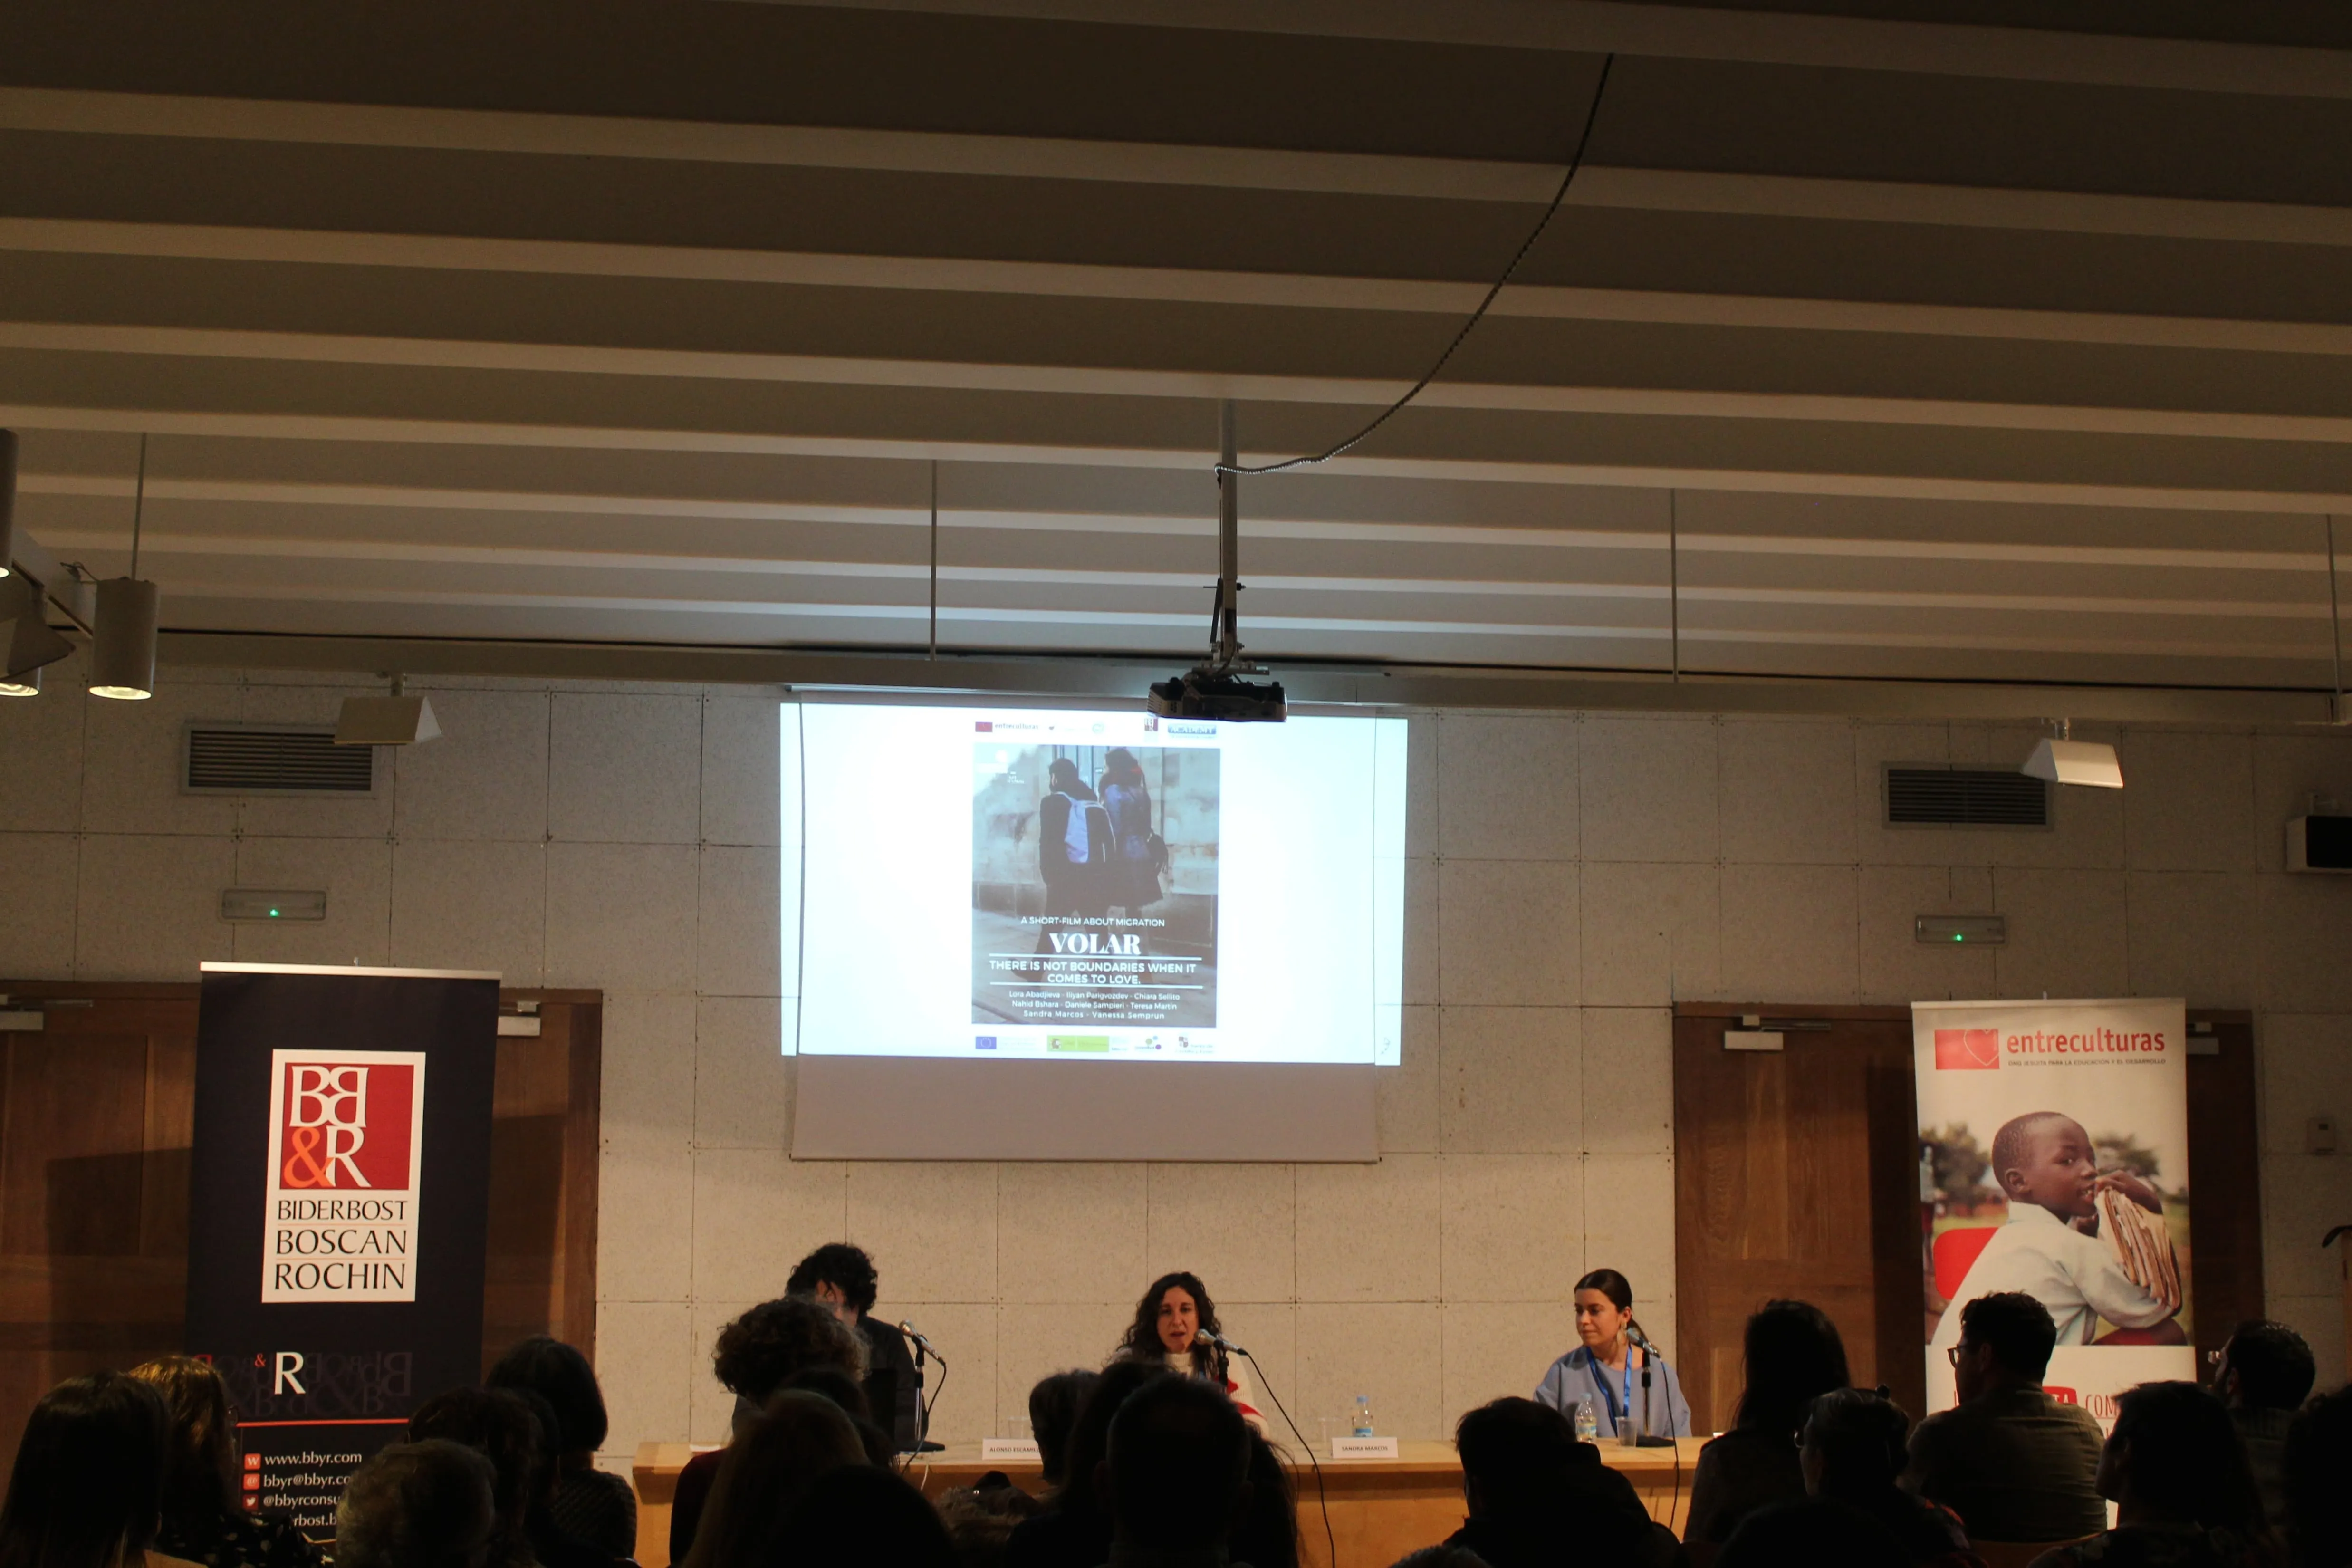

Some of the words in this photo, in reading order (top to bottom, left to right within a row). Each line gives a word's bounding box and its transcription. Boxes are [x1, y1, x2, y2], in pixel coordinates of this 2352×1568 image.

[1021, 916, 1027, 924] A
[1029, 916, 1081, 925] SHORT-FILM
[1083, 917, 1114, 926] ABOUT
[1116, 918, 1165, 926] MIGRATION
[1049, 933, 1142, 955] VOLAR
[989, 960, 1027, 970] THERE
[1030, 961, 1040, 971] IS
[1044, 961, 1067, 971] NOT
[1070, 962, 1145, 972] BOUNDARIES
[1148, 963, 1183, 973] WHEN
[1186, 964, 1197, 973] IT
[1047, 973, 1088, 983] COMES
[1091, 974, 1106, 983] TO
[1109, 975, 1141, 984] LOVE.
[1094, 1001, 1124, 1010] Sampieri
[2007, 1027, 2165, 1053] entreculturas
[278, 1200, 408, 1221] BIDERBOST
[277, 1229, 407, 1255] BOSCAN
[275, 1263, 405, 1290] ROCHIN
[2085, 1394, 2117, 1417] COM
[264, 1451, 362, 1468] www.bbyr.com
[263, 1472, 351, 1491] bbyr@bbyr.co
[263, 1493, 340, 1510] @bbyrconsu
